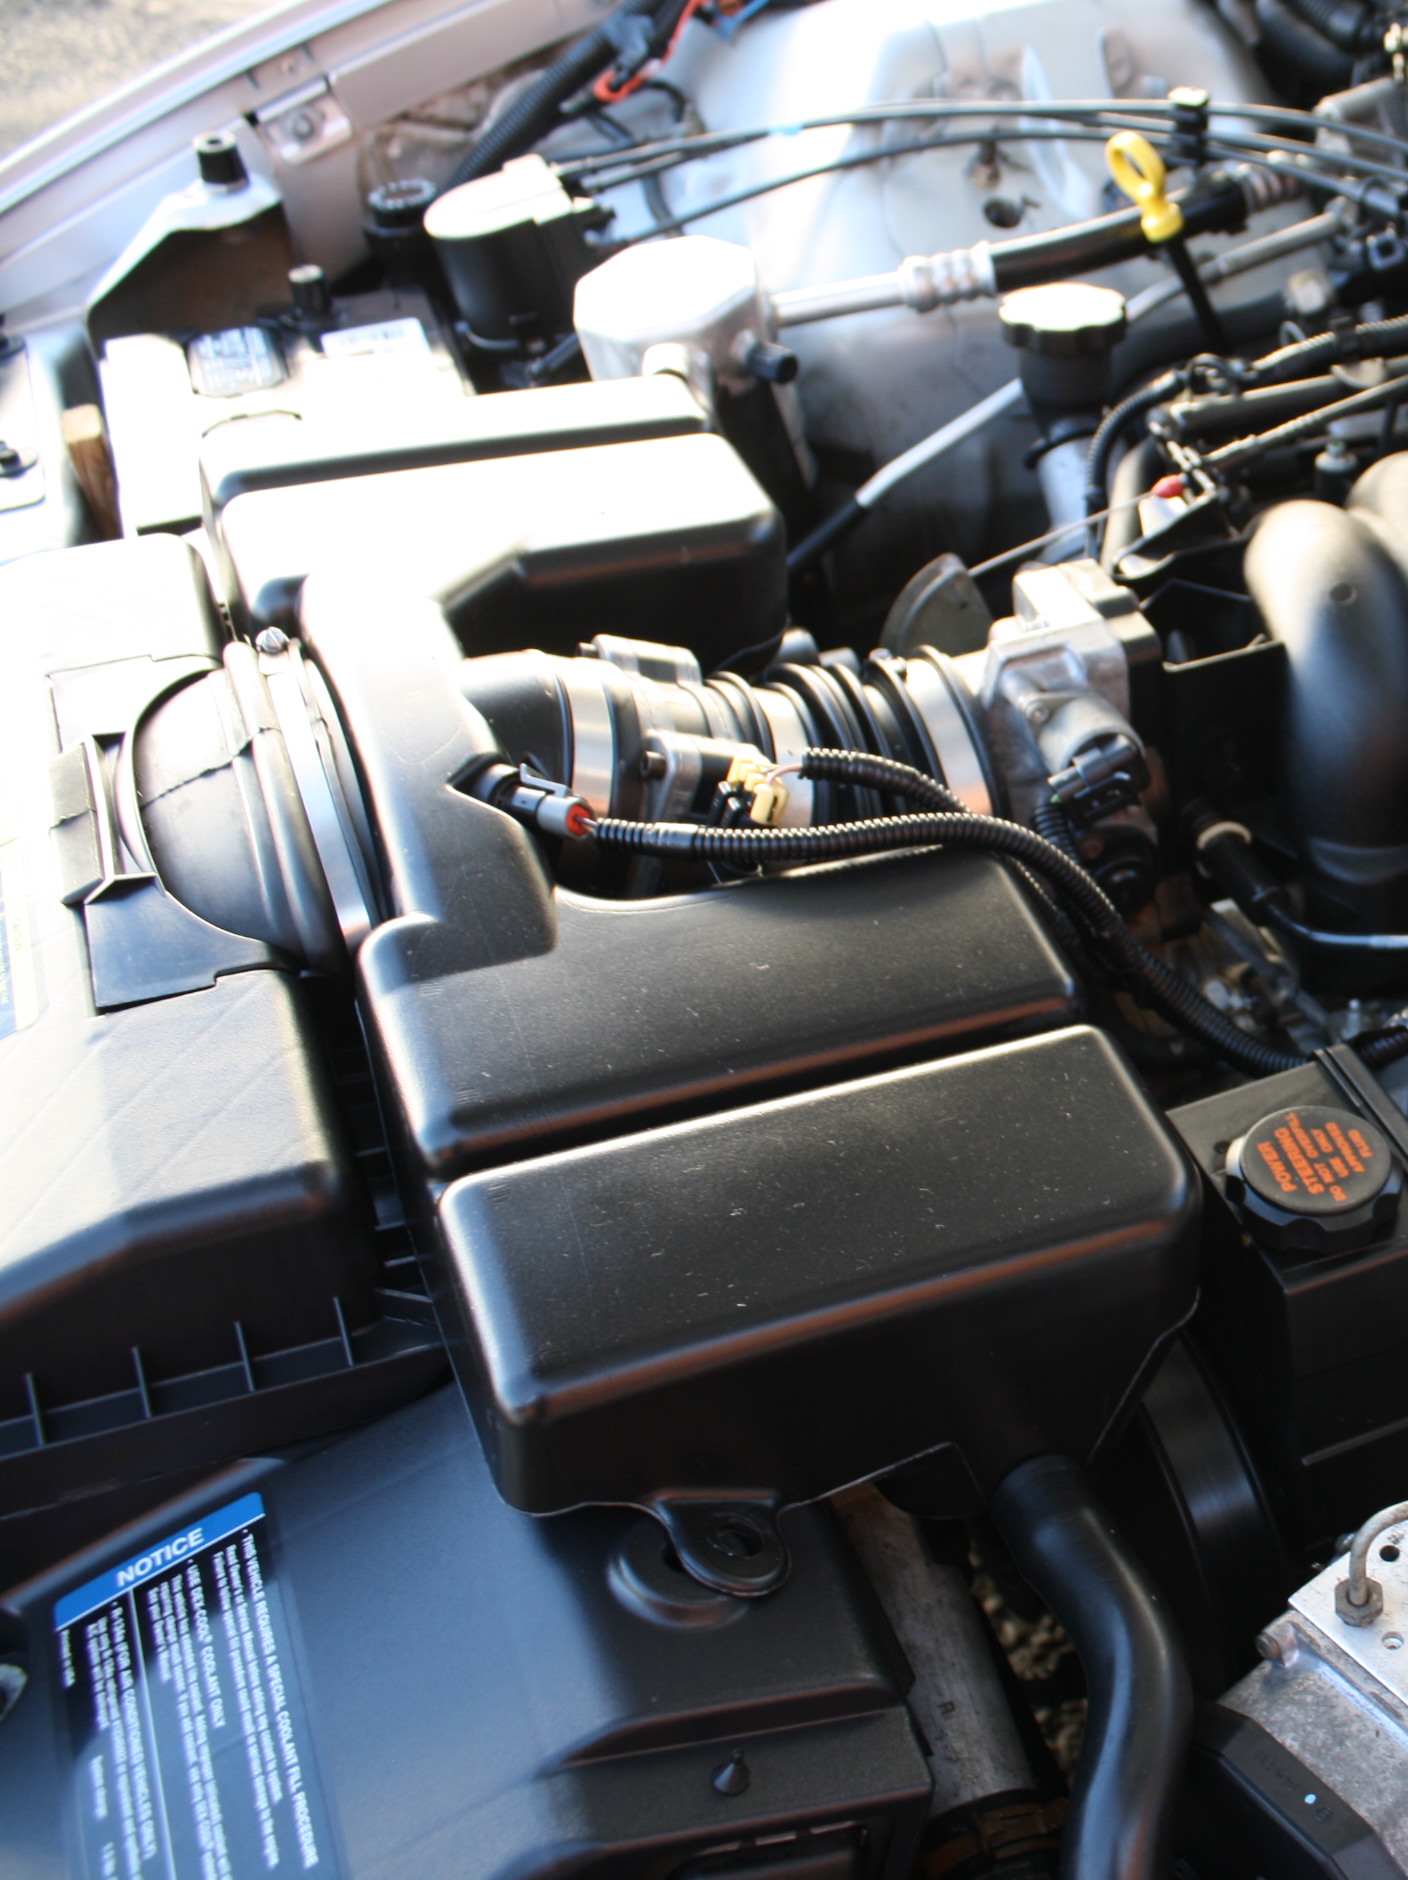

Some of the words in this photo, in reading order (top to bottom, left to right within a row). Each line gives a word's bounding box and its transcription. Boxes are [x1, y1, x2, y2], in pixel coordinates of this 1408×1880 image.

[1285, 1112, 1319, 1159] OVERFILL
[1310, 1128, 1334, 1153] ONLY
[1325, 1121, 1366, 1172] APPROVED
[1348, 1129, 1373, 1158] FLUID
[1256, 1141, 1298, 1192] POWER
[1274, 1127, 1324, 1194] STEERING
[1314, 1163, 1335, 1184] NOT
[1328, 1156, 1349, 1178] USE
[1329, 1185, 1347, 1202] DO
[116, 1528, 205, 1588] NOTICE
[244, 1533, 256, 1559] THIS
[187, 1563, 200, 1588] USE
[248, 1556, 265, 1600] VEHICLE
[111, 1606, 126, 1643] R-134a
[256, 1600, 275, 1655] REQUIRES
[116, 1641, 130, 1671] (FOR
[201, 1645, 220, 1698] COOLANT
[267, 1655, 277, 1665] A
[120, 1668, 133, 1690] AIR
[268, 1663, 286, 1711] SPECIAL
[123, 1688, 144, 1766] CONDITIONED
[210, 1697, 225, 1729] ONLY
[277, 1710, 297, 1765] COOLANT
[134, 1762, 152, 1822] VEHICLES
[288, 1765, 303, 1793] FILL
[141, 1819, 158, 1860] ONLY)
[293, 1791, 318, 1868] PROCEDURE
